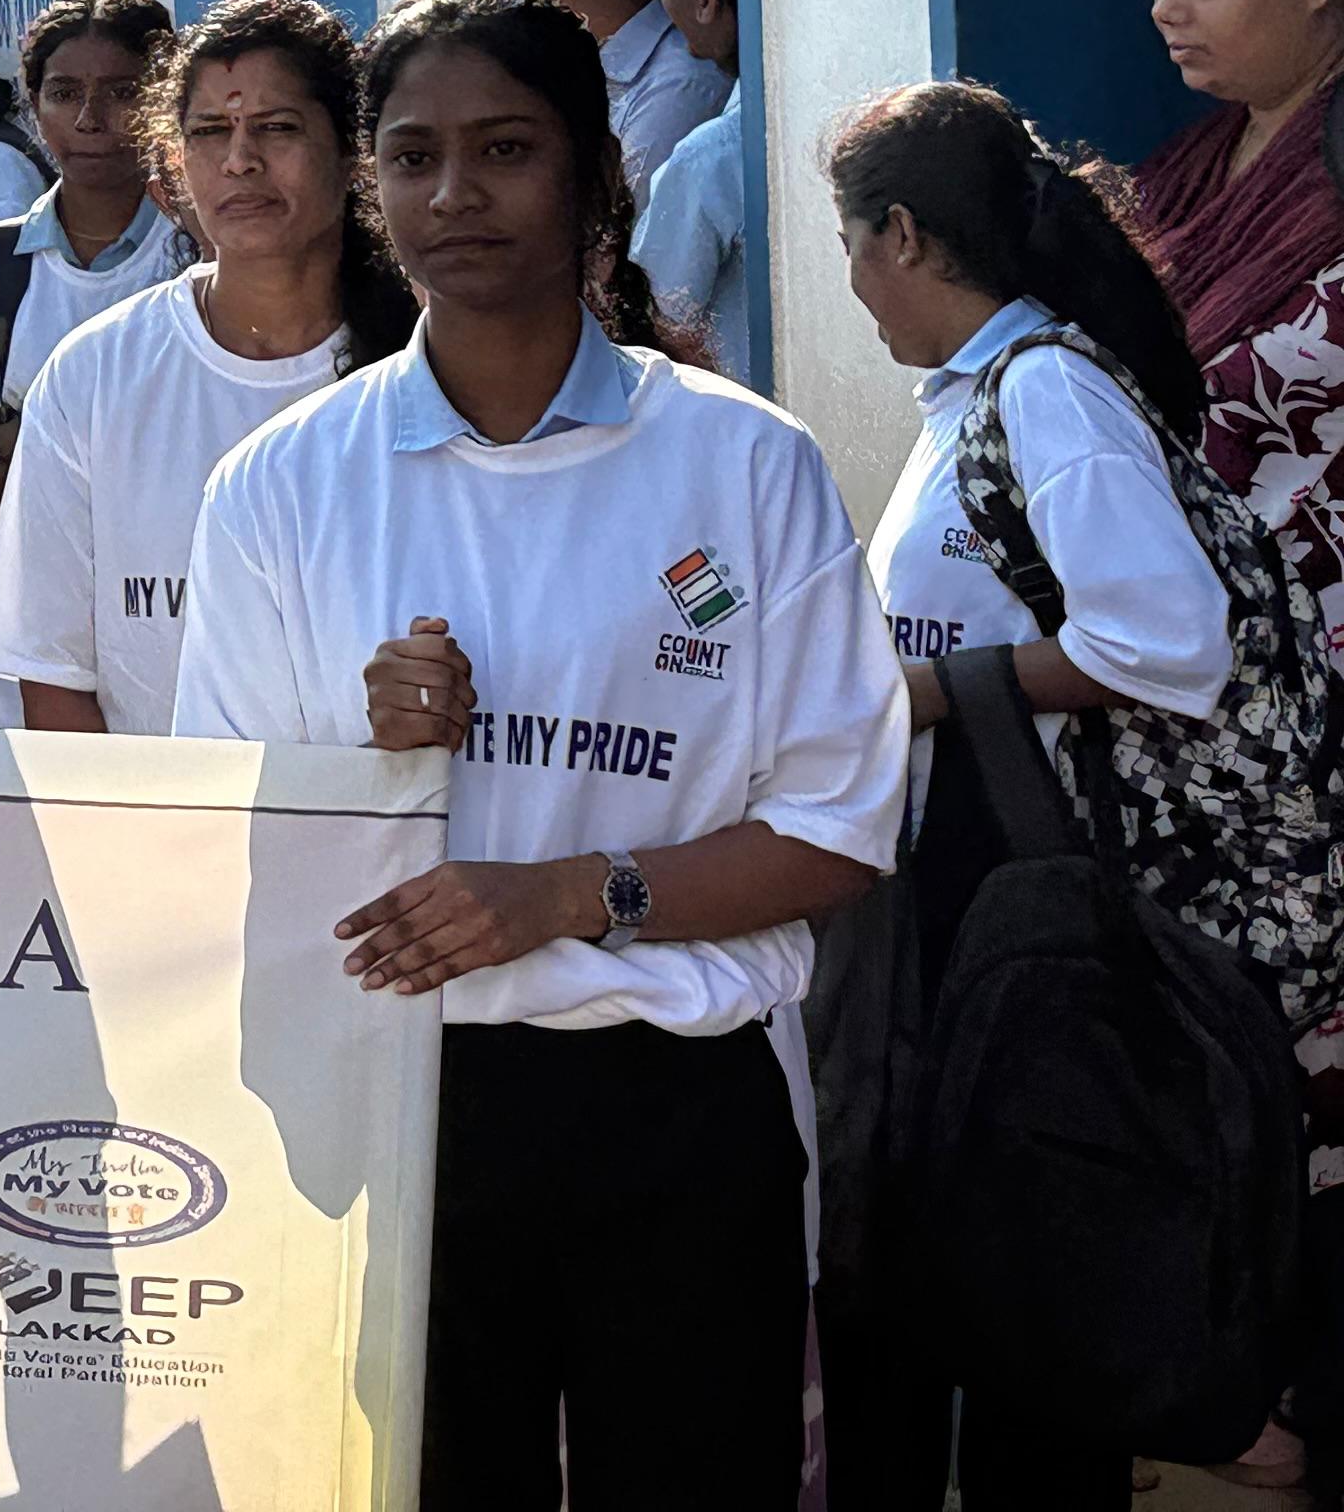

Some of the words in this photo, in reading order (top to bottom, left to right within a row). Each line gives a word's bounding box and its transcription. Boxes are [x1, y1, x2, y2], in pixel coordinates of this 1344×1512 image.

[124, 576, 156, 618] MY
[659, 633, 731, 669] COUNT
[885, 614, 964, 658] RIDE
[655, 653, 683, 673] ON
[508, 714, 559, 768] MY
[568, 719, 678, 782] PRIDE
[3, 1173, 70, 1198] My
[79, 1177, 179, 1201] Vote
